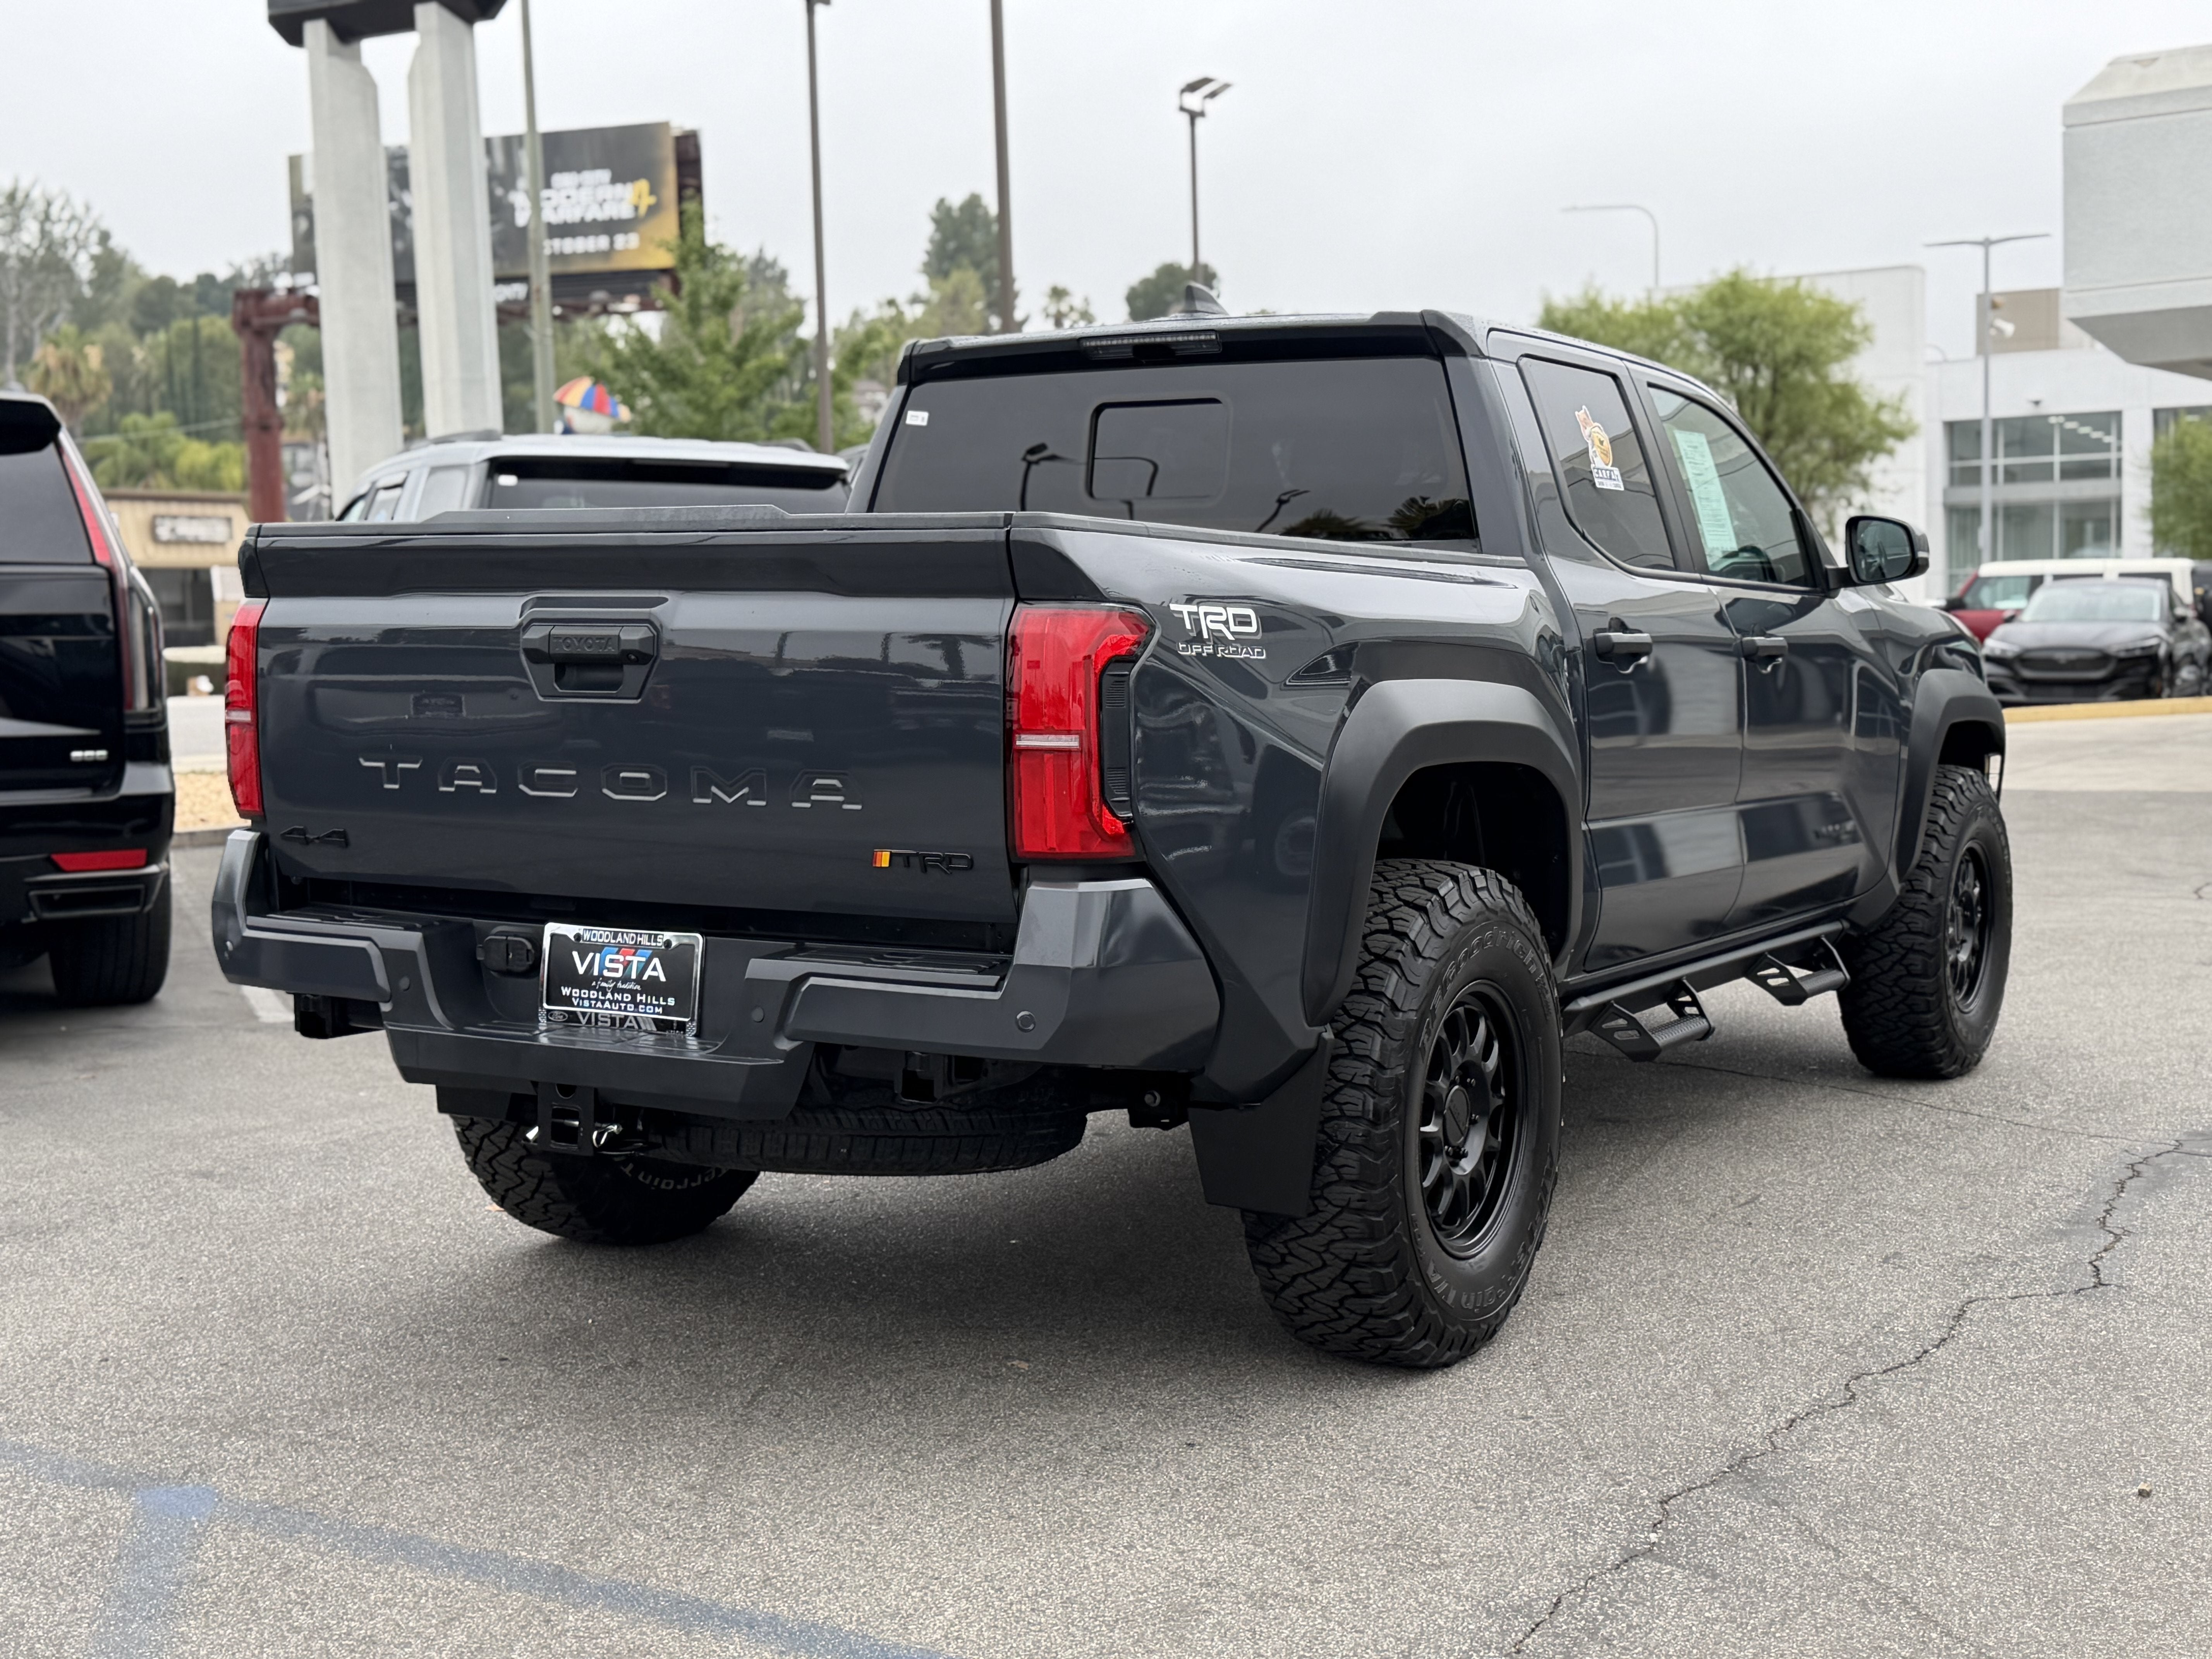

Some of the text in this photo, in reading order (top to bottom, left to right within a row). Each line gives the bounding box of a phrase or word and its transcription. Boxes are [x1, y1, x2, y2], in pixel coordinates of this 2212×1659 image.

[1169, 603, 1257, 641] TRD
[552, 636, 615, 652] TOYOTA
[1177, 642, 1266, 659] OFF ROAD
[358, 755, 863, 810] TACOMA
[891, 849, 974, 874] TRD
[583, 930, 663, 946] WOODLAND HILLS
[572, 951, 666, 982] VISTA
[576, 1011, 639, 1030] VISTA
